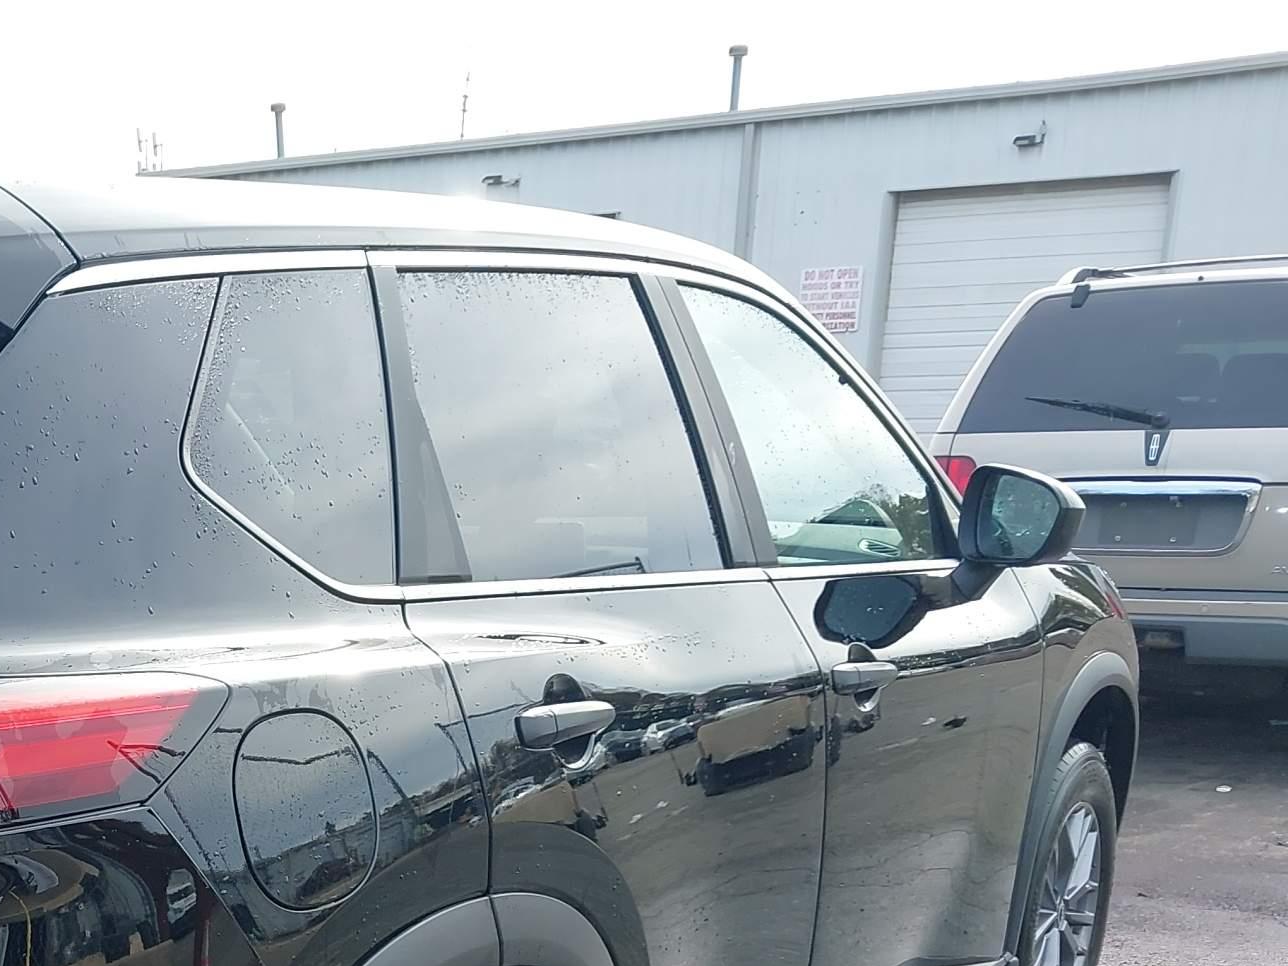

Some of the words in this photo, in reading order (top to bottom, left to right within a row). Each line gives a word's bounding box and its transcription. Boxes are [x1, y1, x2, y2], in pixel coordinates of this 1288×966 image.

[804, 270, 816, 281] DO
[818, 269, 834, 281] NOT
[837, 268, 858, 280] OPEN
